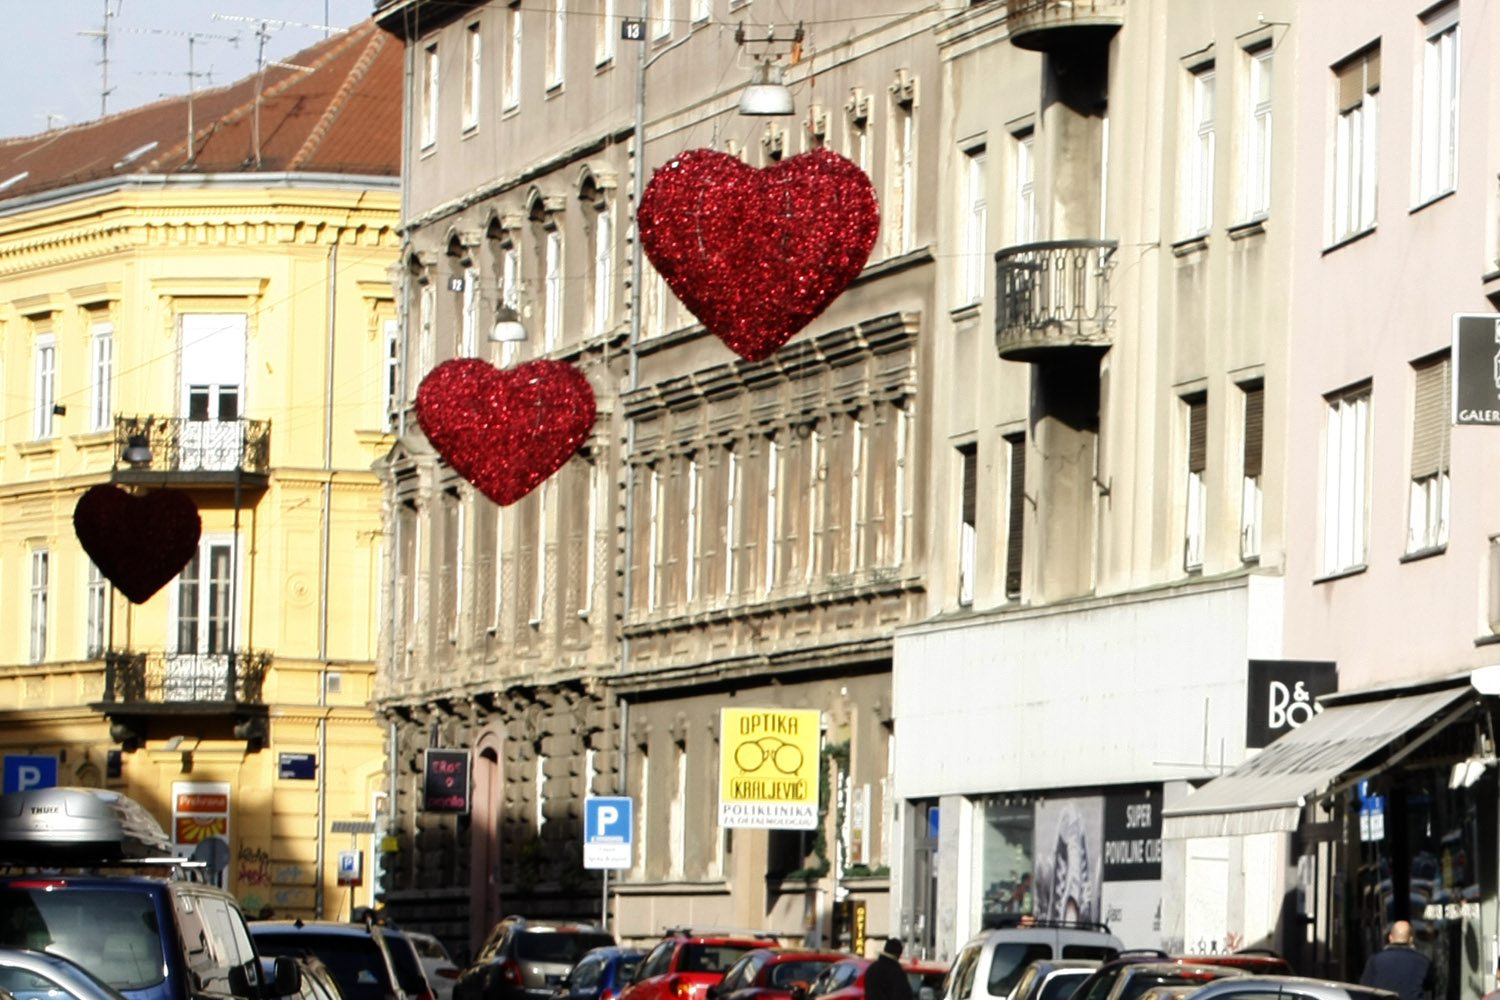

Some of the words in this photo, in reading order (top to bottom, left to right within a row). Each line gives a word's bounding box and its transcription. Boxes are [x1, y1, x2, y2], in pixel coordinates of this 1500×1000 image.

[740, 713, 798, 735] OPTIKA
[18, 766, 41, 792] P
[31, 807, 60, 815] THULE
[597, 806, 618, 837] P
[723, 804, 813, 817] POLIKLINIKA
[1126, 803, 1151, 828] SUPER
[856, 907, 865, 955] OPTIKA
